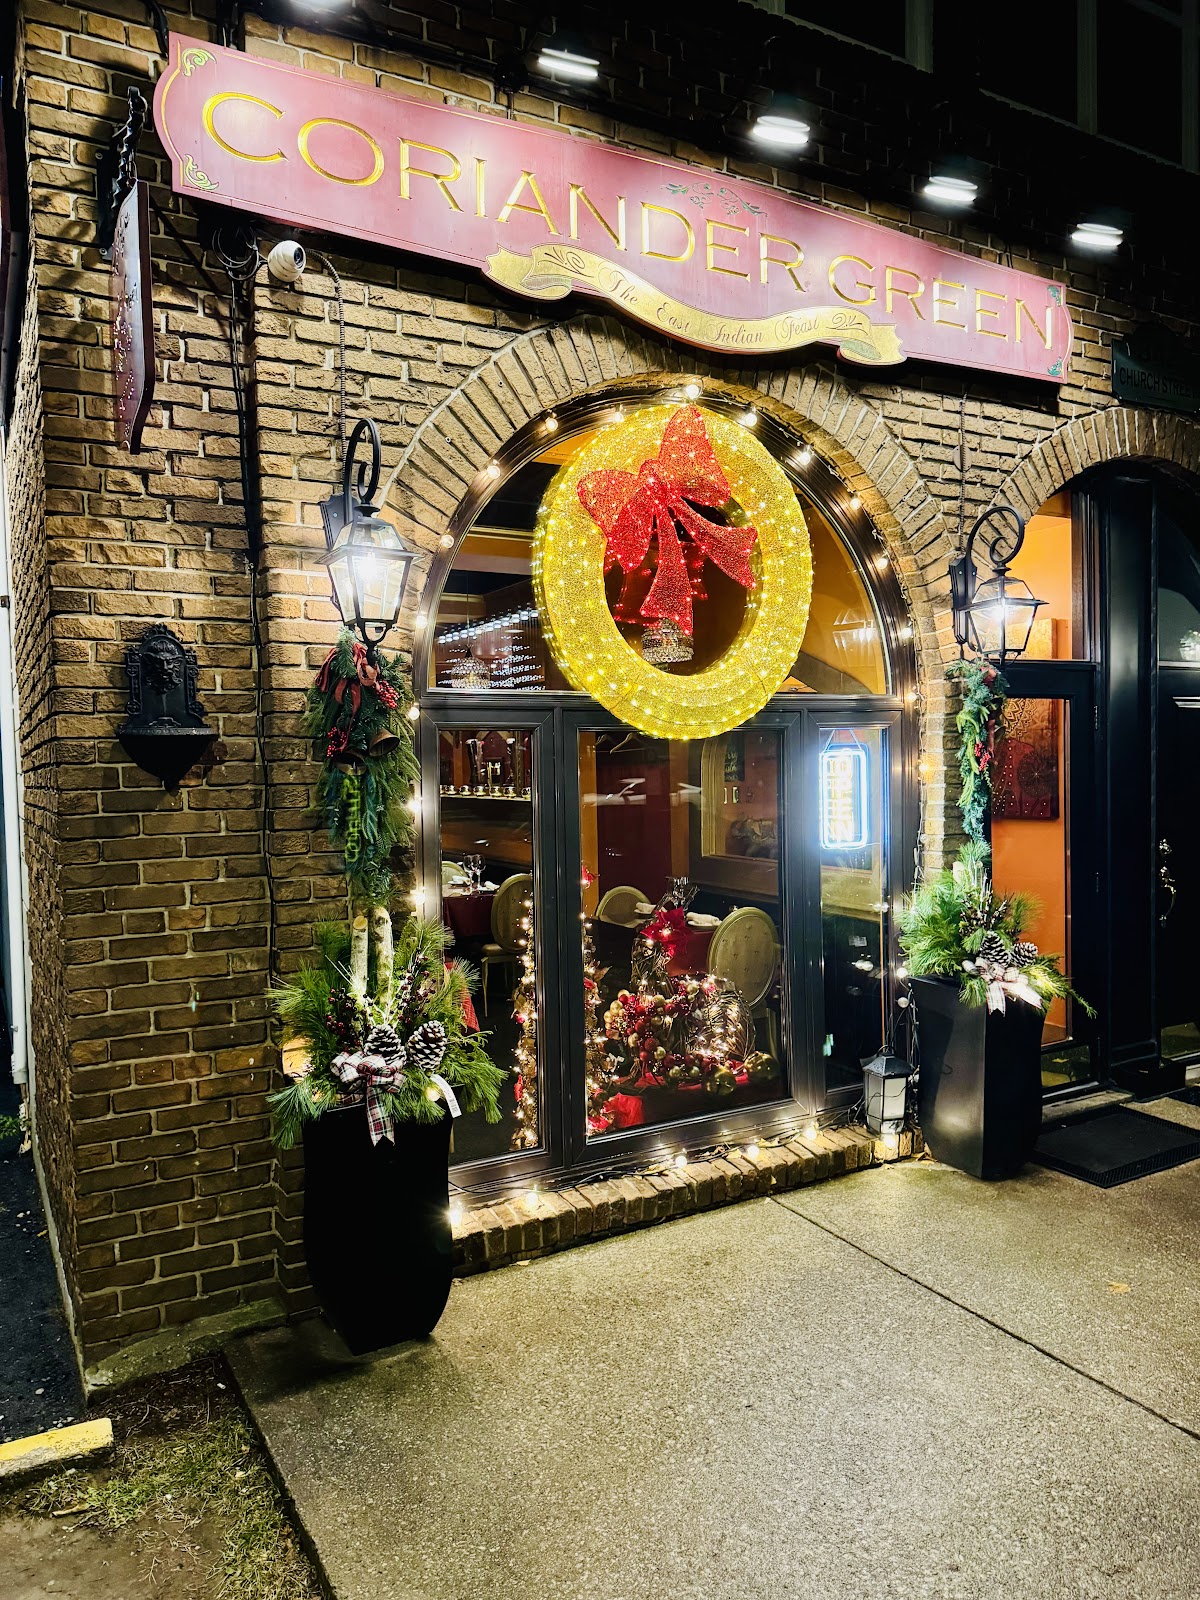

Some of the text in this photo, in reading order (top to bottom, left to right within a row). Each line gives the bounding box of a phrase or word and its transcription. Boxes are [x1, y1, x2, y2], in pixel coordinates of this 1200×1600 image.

[202, 91, 1053, 350] CORIANDER GREEN
[597, 258, 820, 346] The East Indian Feast
[1119, 367, 1197, 399] CHURCH STREE
